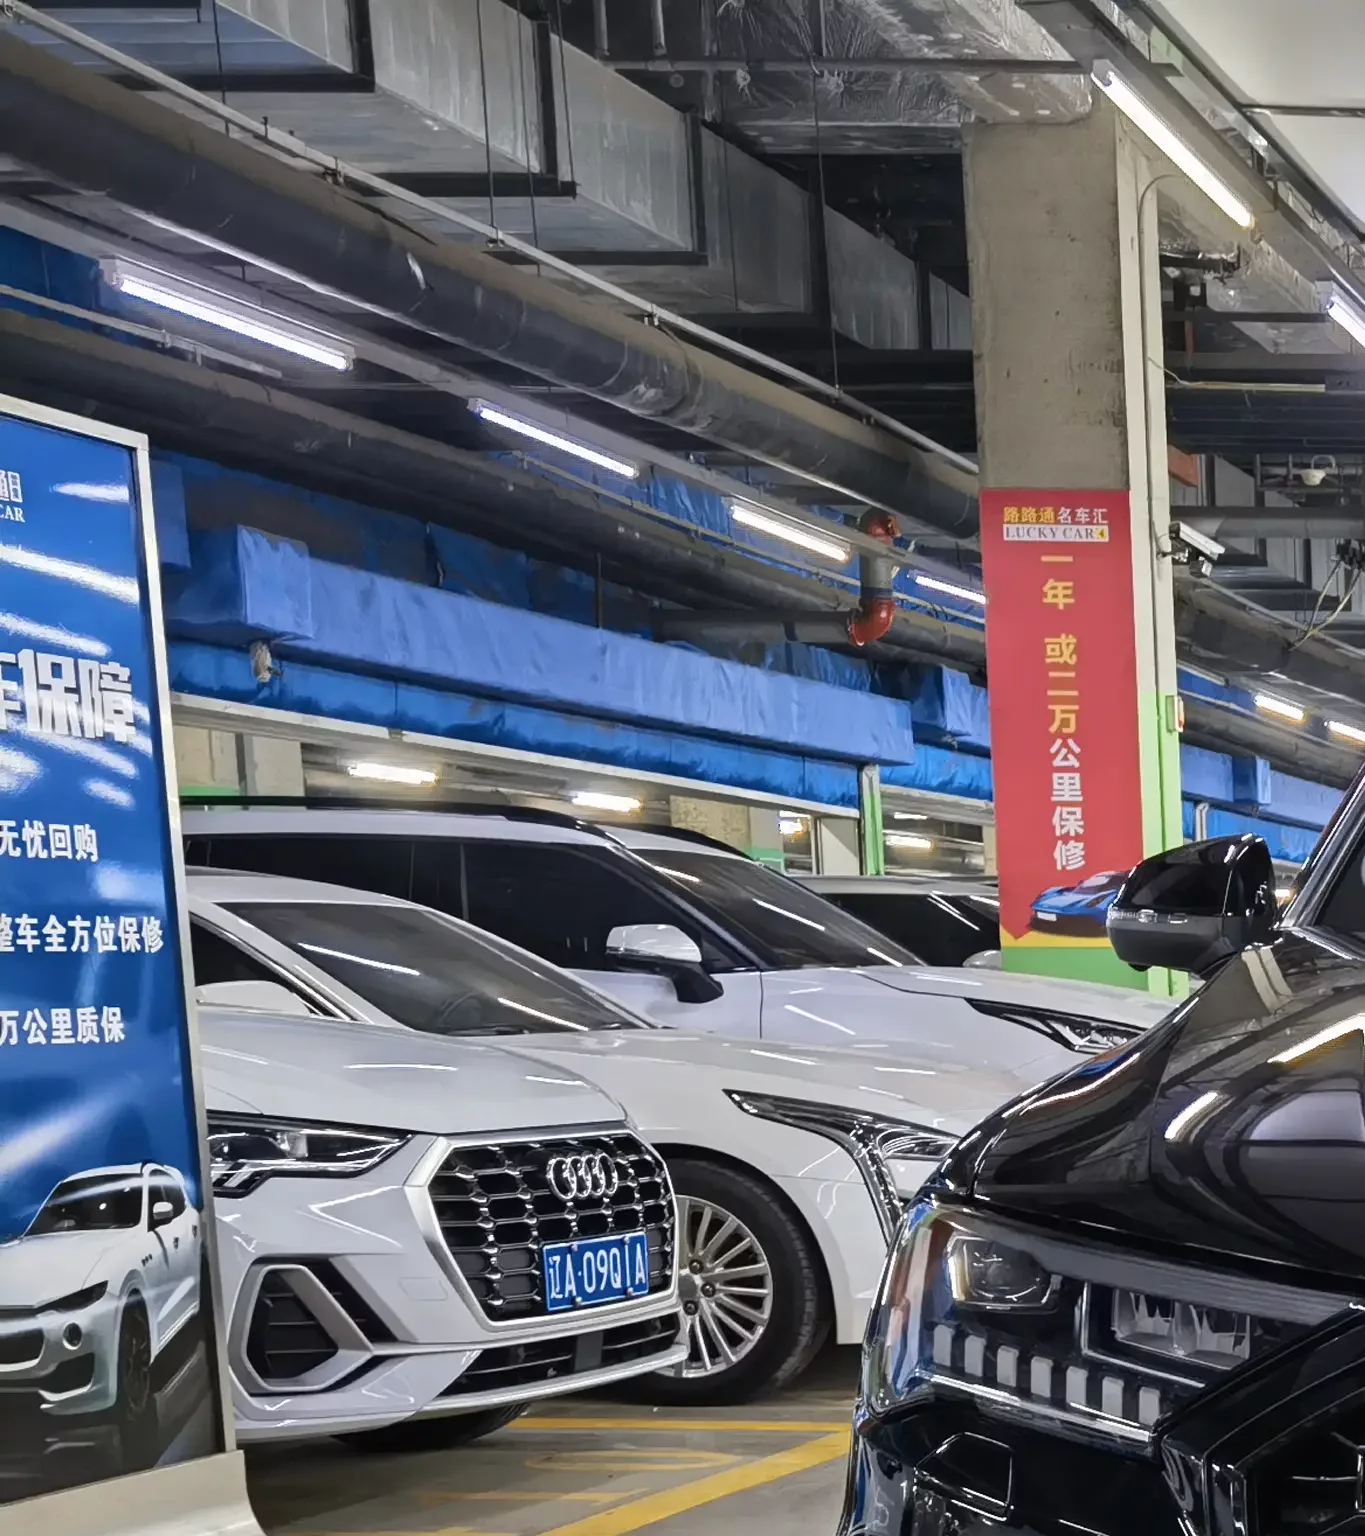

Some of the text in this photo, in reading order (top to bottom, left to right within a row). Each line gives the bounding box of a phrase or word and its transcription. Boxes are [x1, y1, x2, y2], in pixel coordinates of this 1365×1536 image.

[1005, 526, 1094, 540] LUCKY CAR
[0, 819, 99, 862] 无忧回购
[0, 1005, 126, 1046] 万公里质保
